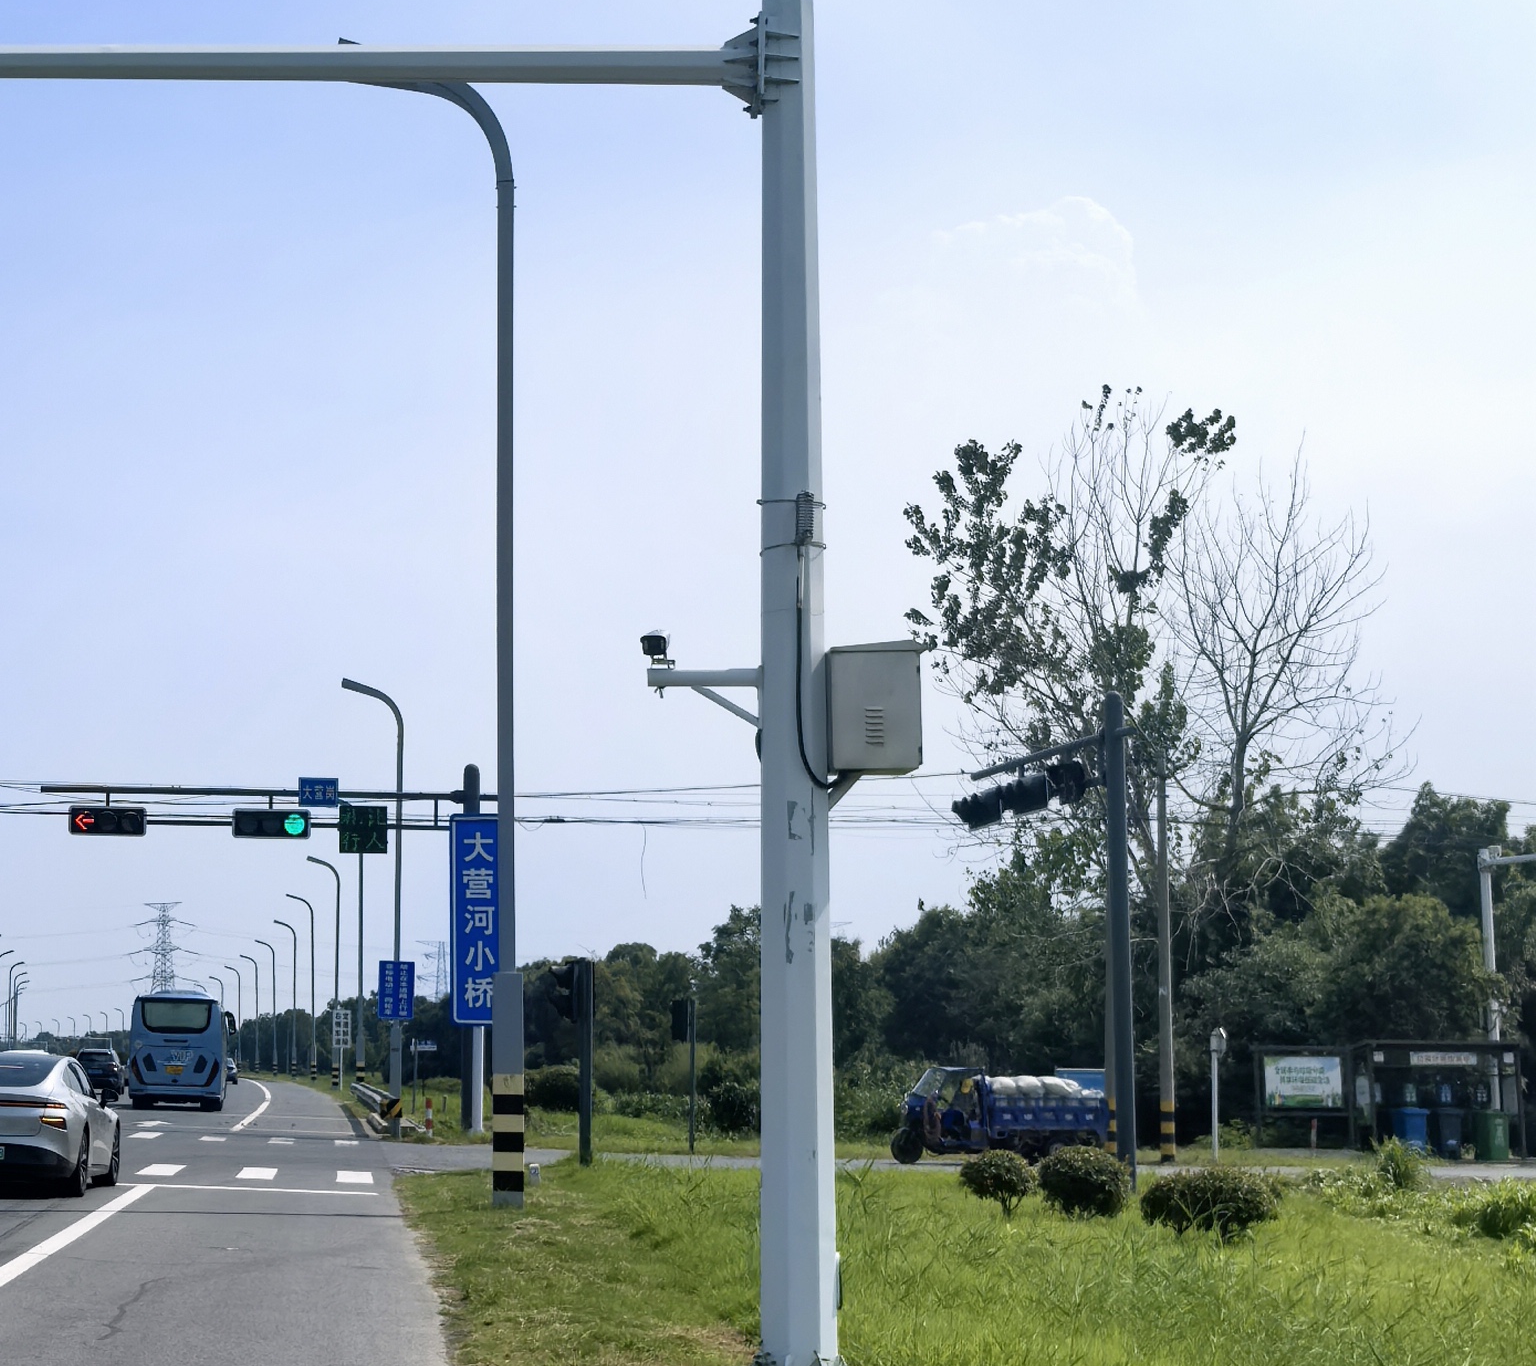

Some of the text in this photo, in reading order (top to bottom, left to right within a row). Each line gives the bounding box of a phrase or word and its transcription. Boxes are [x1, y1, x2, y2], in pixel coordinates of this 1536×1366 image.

[302, 785, 335, 801] 大营岗
[462, 832, 496, 1008] 大营河小桥
